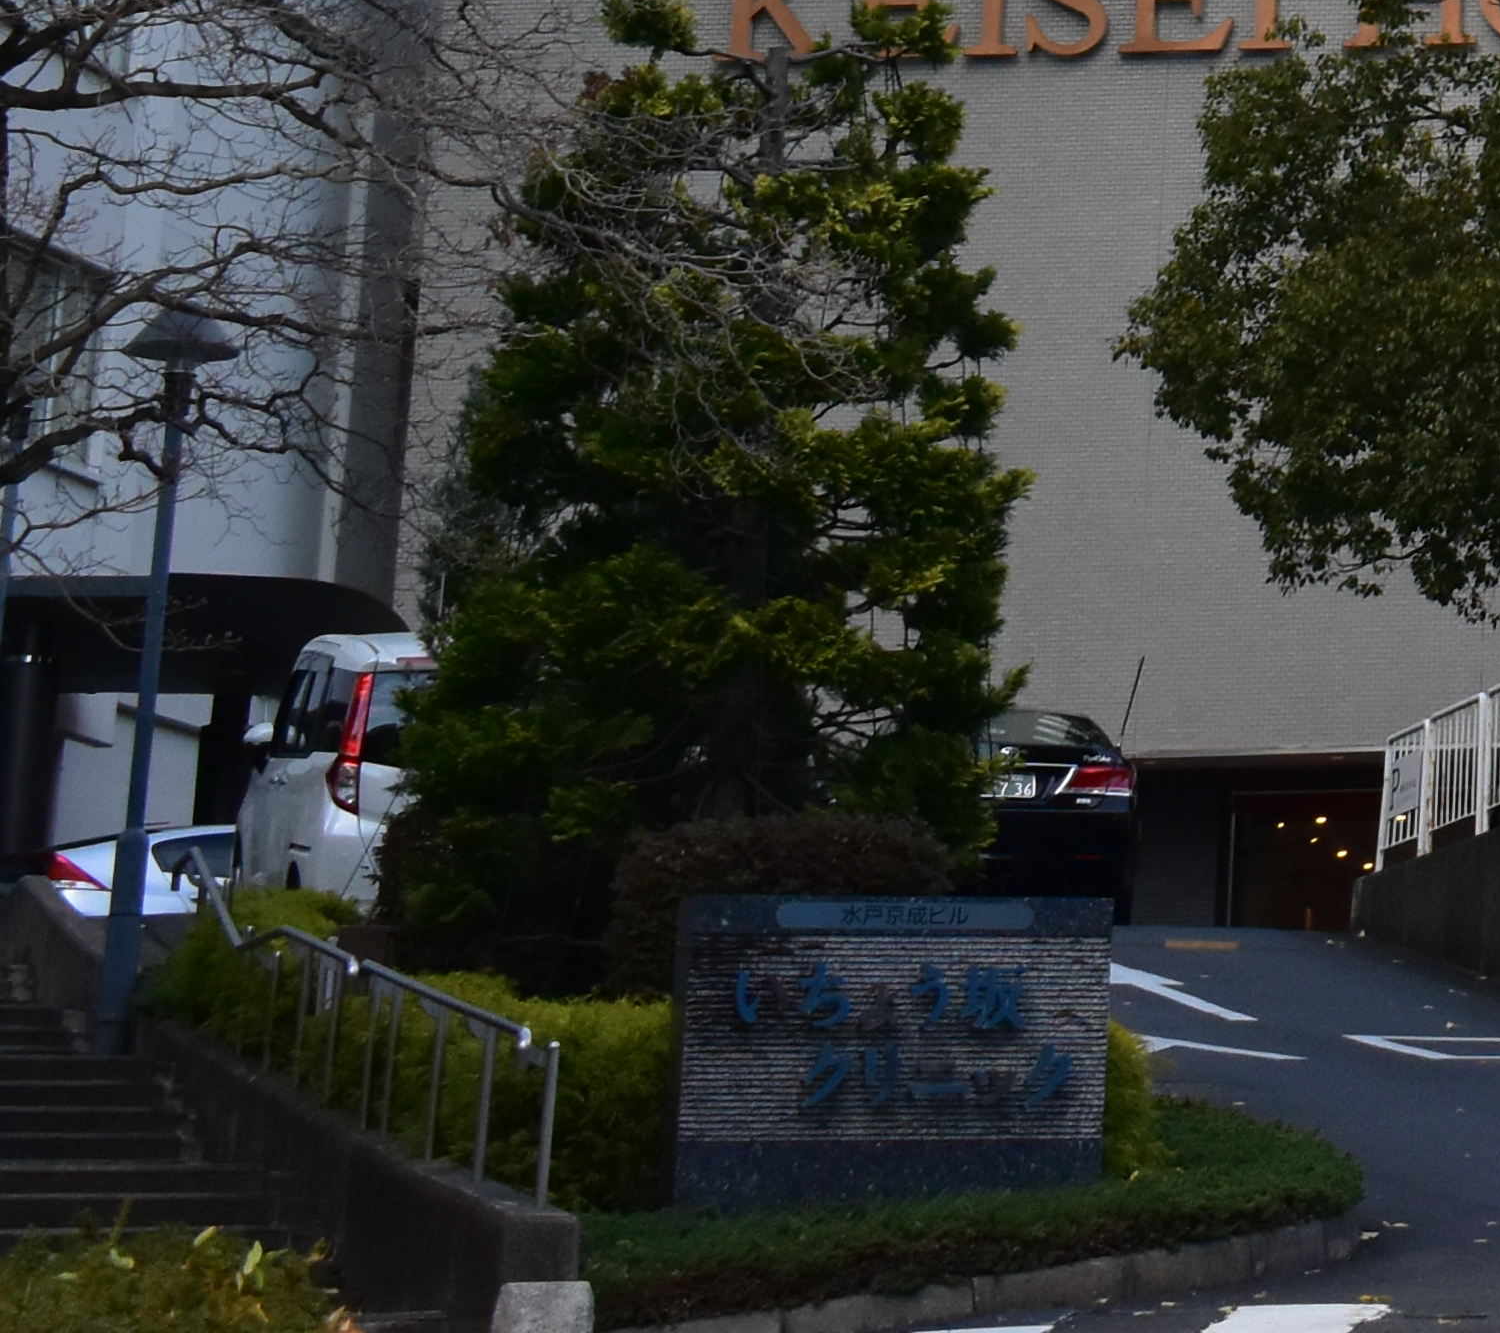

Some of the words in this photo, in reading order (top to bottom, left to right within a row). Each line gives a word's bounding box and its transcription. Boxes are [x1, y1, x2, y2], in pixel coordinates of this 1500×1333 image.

[841, 904, 969, 927] 水戸京成ビル
